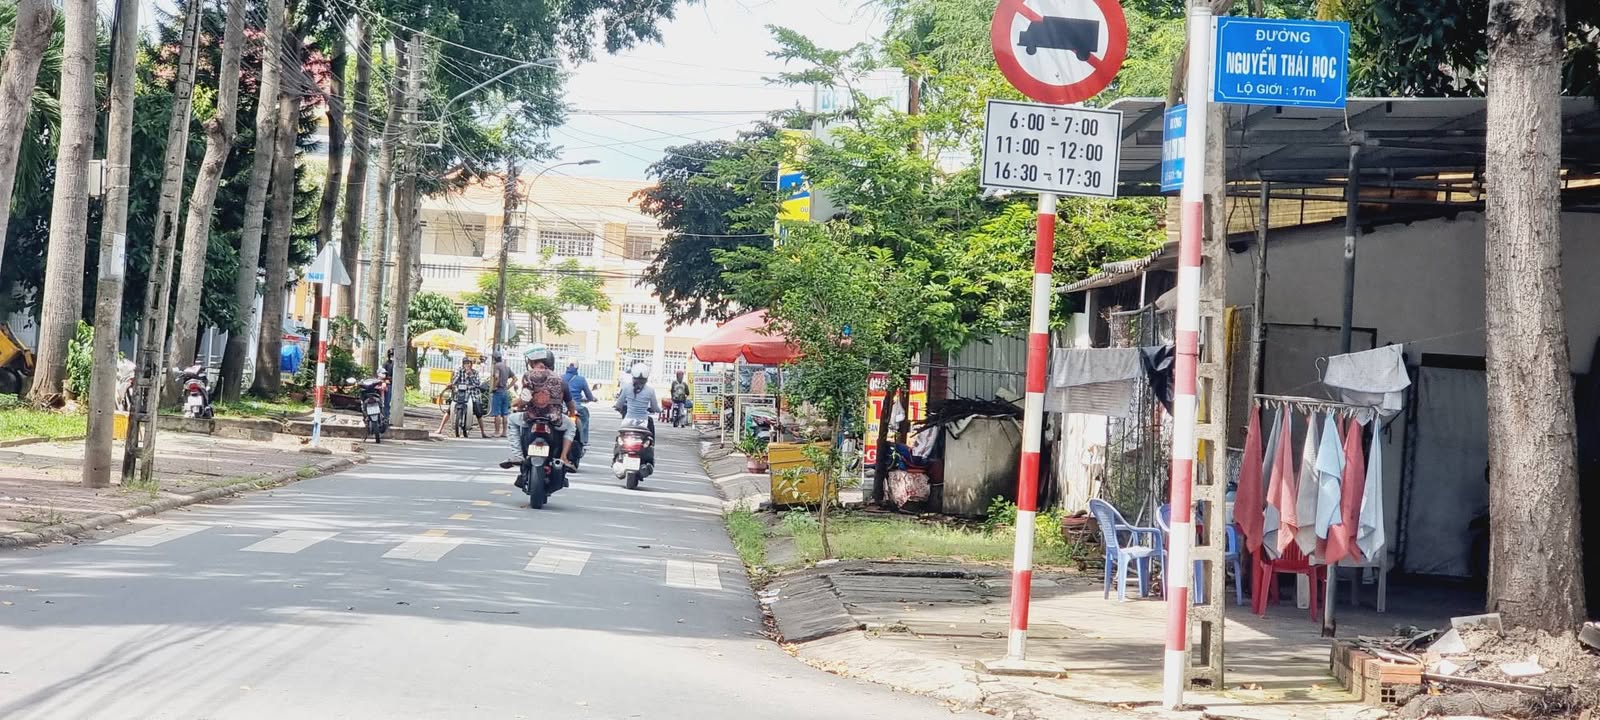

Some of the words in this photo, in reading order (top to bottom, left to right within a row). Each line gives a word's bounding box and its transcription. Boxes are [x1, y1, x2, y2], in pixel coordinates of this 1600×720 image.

[1255, 28, 1311, 43] ĐƯỜNG
[1226, 47, 1277, 76] NGUYỄN
[1281, 50, 1309, 77] THÁI
[1312, 55, 1337, 83] HỌC
[1236, 81, 1254, 95] LỘ
[1256, 82, 1283, 95] GIỚI
[1292, 86, 1317, 97] 17m
[1010, 112, 1045, 131] 6:00
[1064, 116, 1099, 136] 7:00
[996, 136, 1040, 156] 11:00
[1060, 141, 1103, 161] 12:00
[994, 161, 1038, 182] 16:30
[1058, 168, 1101, 188] 17:30
